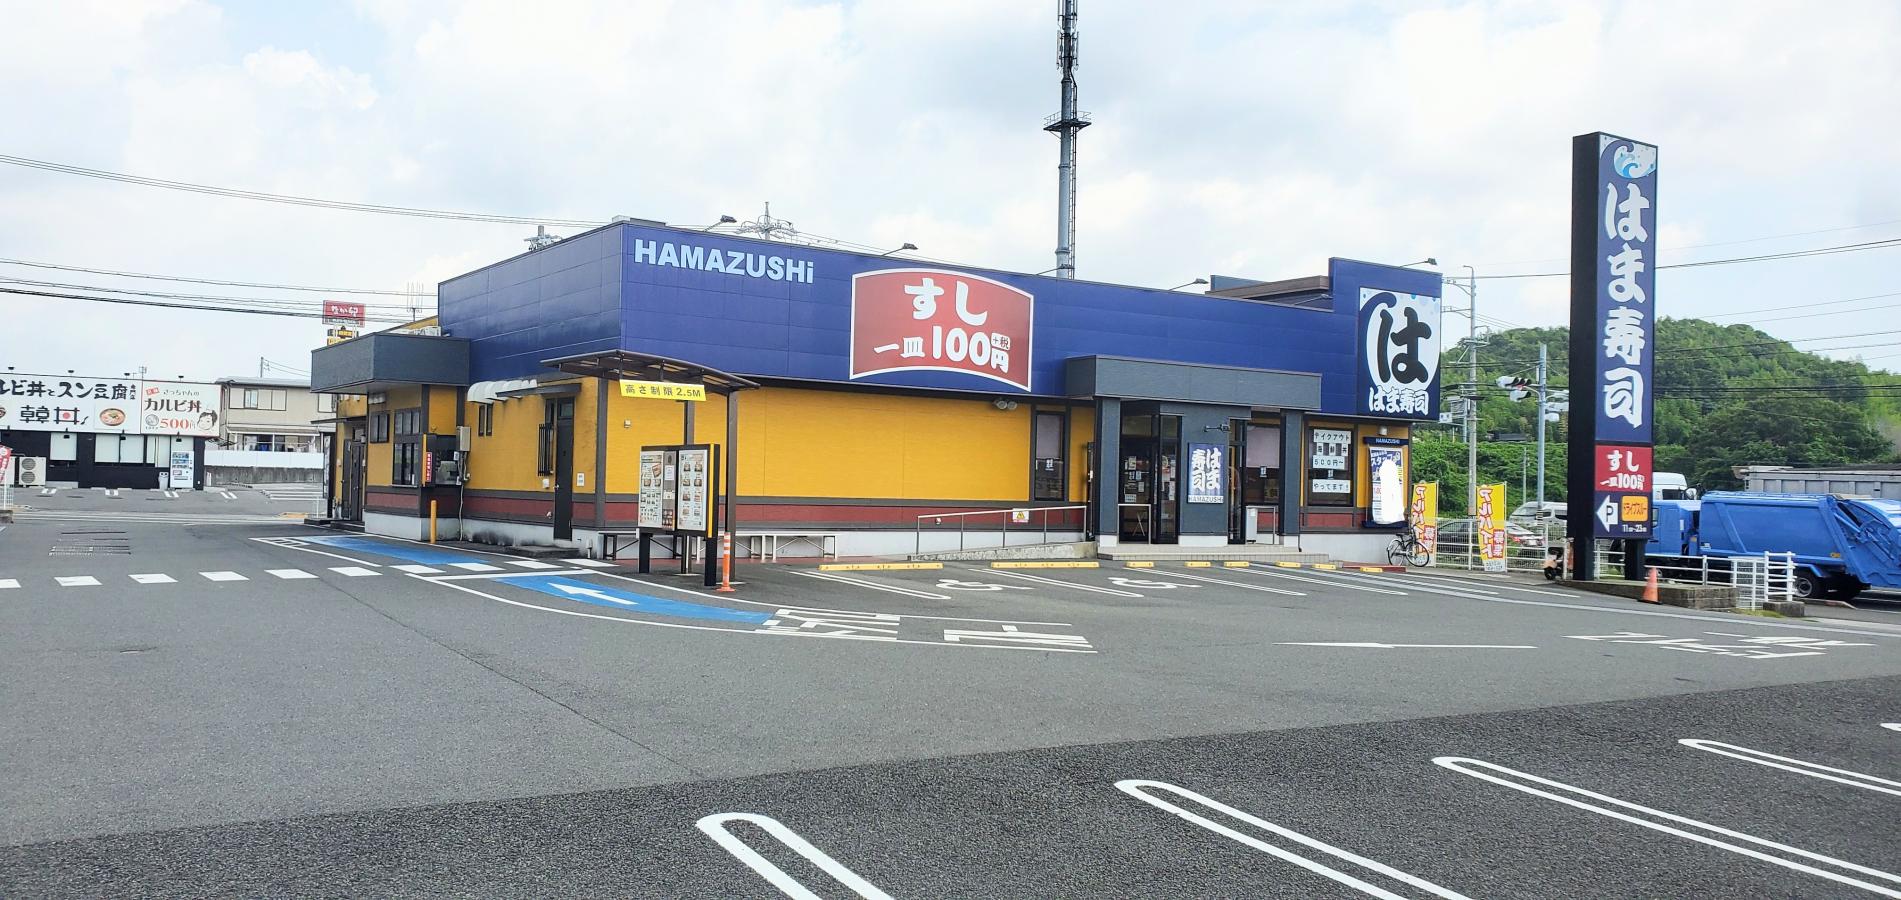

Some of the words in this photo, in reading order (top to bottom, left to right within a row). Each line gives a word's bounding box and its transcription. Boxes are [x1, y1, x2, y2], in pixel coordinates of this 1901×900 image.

[904, 278, 988, 326] すし
[1603, 182, 1649, 429] はま寿司
[1377, 307, 1432, 384] は
[144, 398, 202, 413] カルビ丼
[1369, 387, 1429, 415] はま寿司
[1315, 432, 1350, 442] テイクアウト
[1606, 449, 1640, 472] すし
[1606, 505, 1614, 522] P
